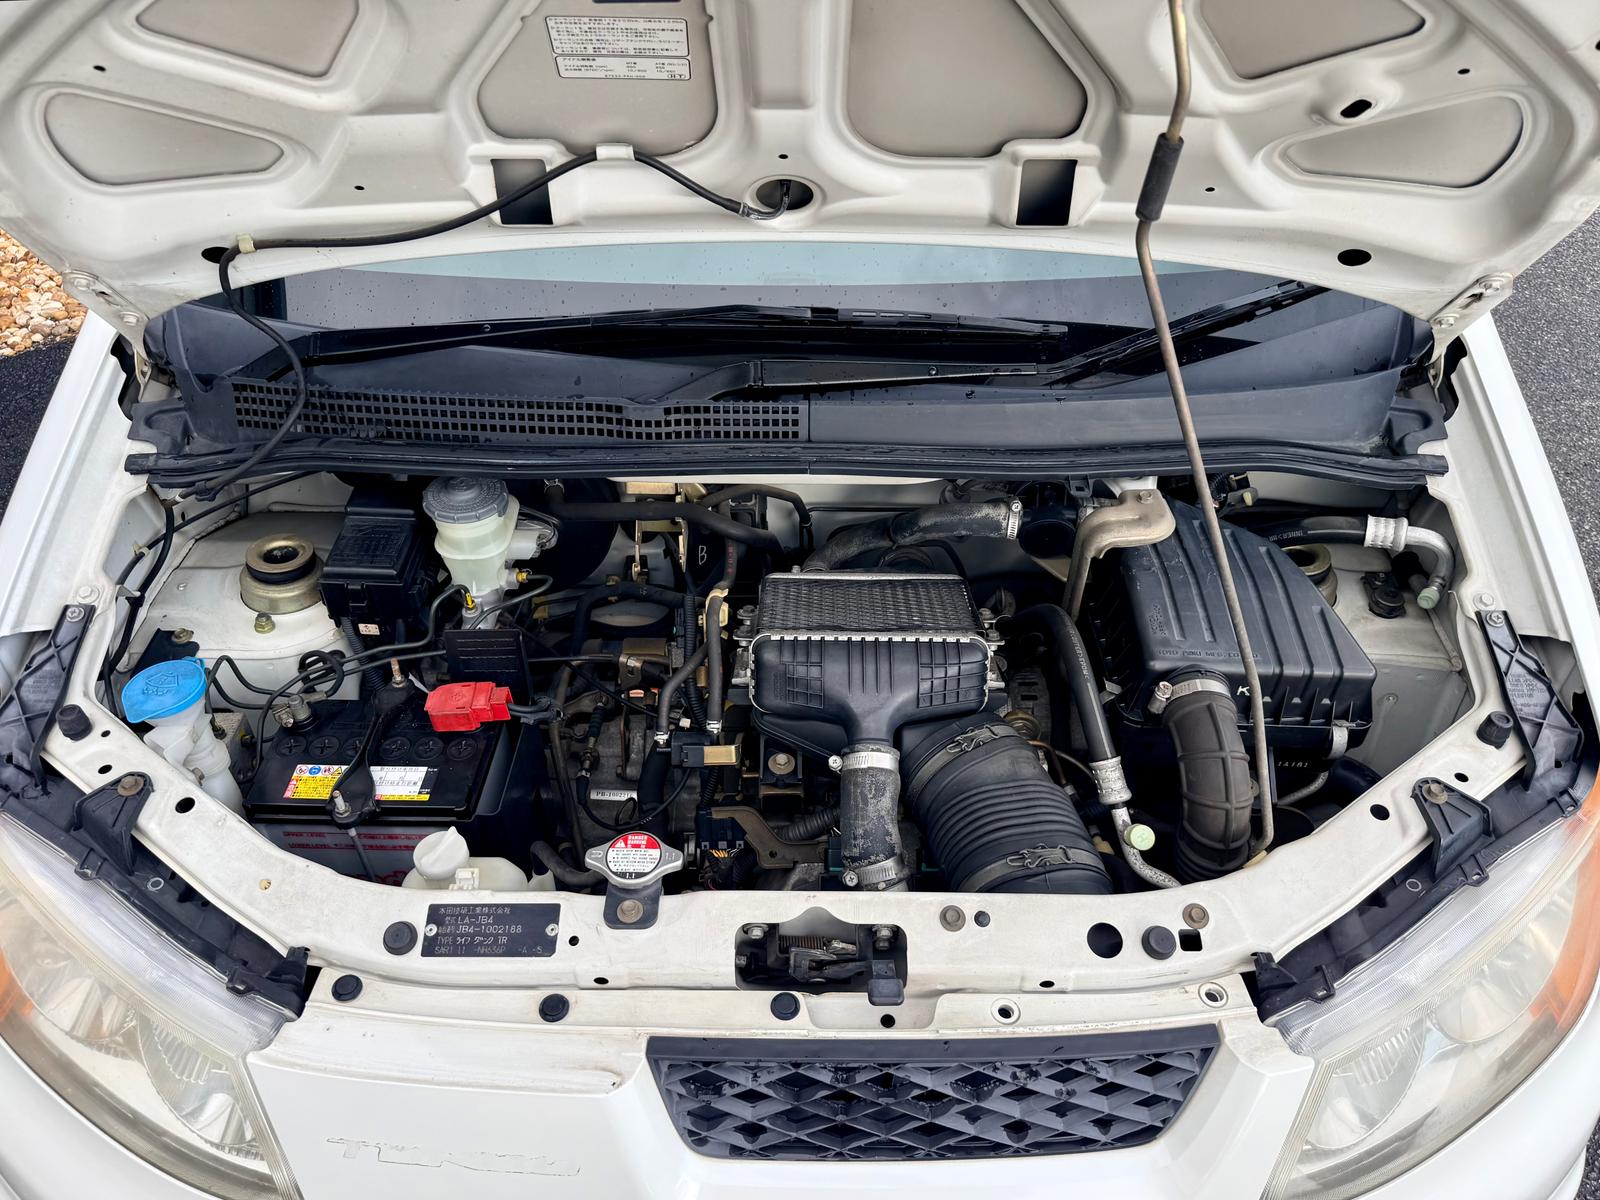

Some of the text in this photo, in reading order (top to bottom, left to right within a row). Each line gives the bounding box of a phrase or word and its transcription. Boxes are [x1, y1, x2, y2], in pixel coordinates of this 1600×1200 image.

[458, 916, 494, 924] LA-JB4
[456, 925, 522, 934] JB4-1002188
[437, 936, 453, 944] TYPE
